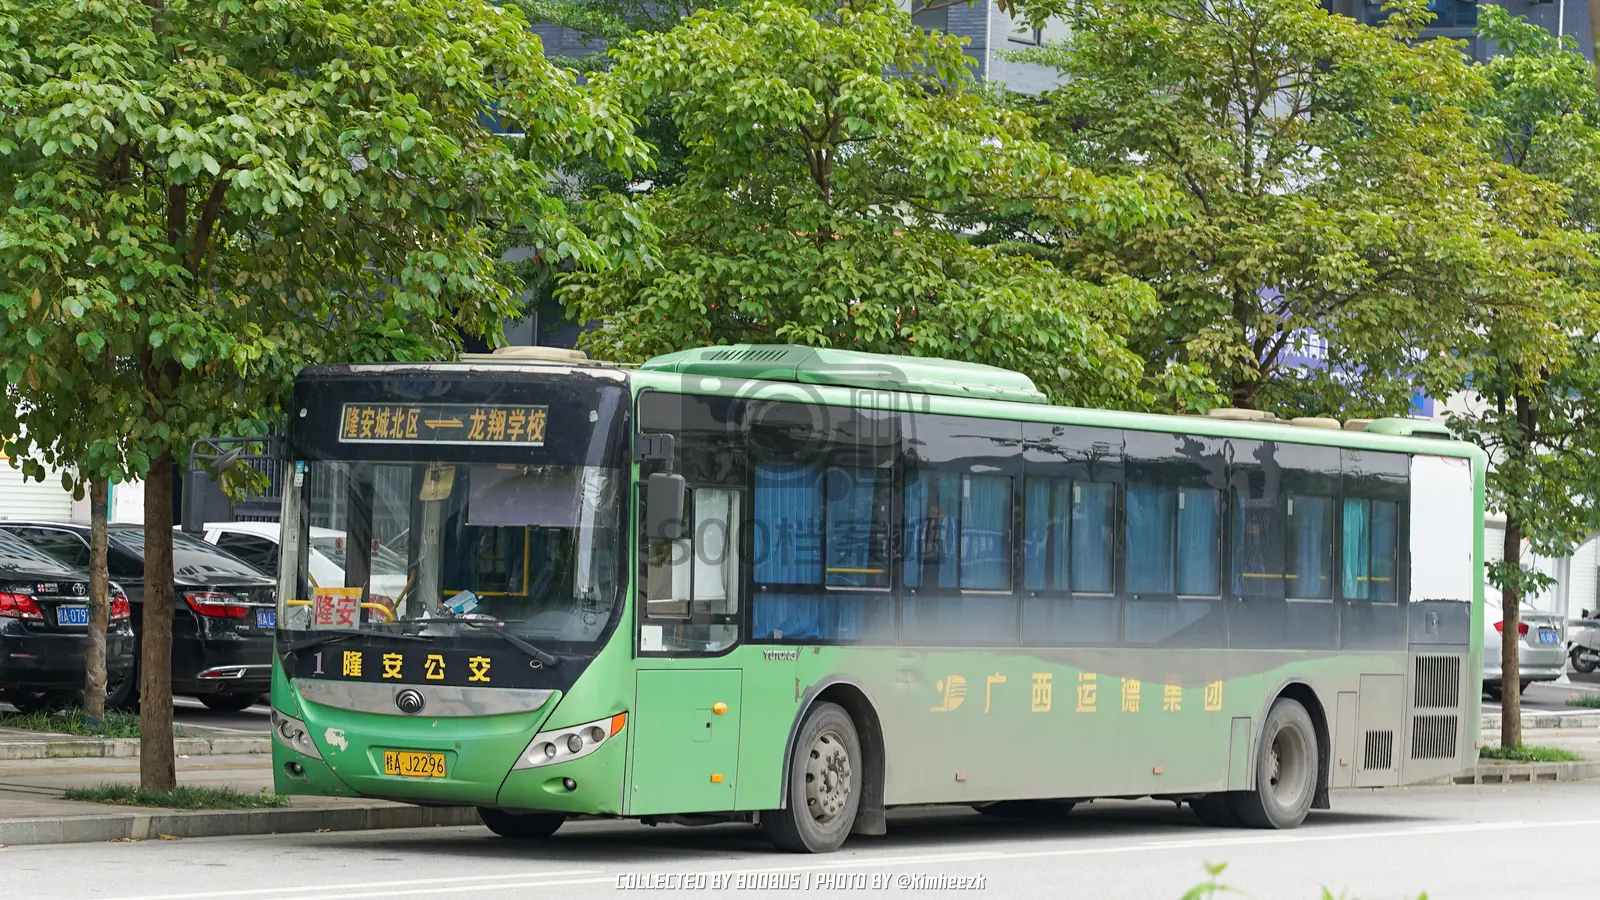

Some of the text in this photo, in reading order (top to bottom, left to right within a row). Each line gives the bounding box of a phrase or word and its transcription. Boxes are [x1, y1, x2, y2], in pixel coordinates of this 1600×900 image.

[344, 407, 545, 441] 隆安城北区 龙翔学校
[315, 595, 357, 625] 隆安
[313, 651, 491, 682] 1 隆安公交
[763, 650, 797, 660] YUTONG
[985, 671, 1223, 713] 广西运德集团
